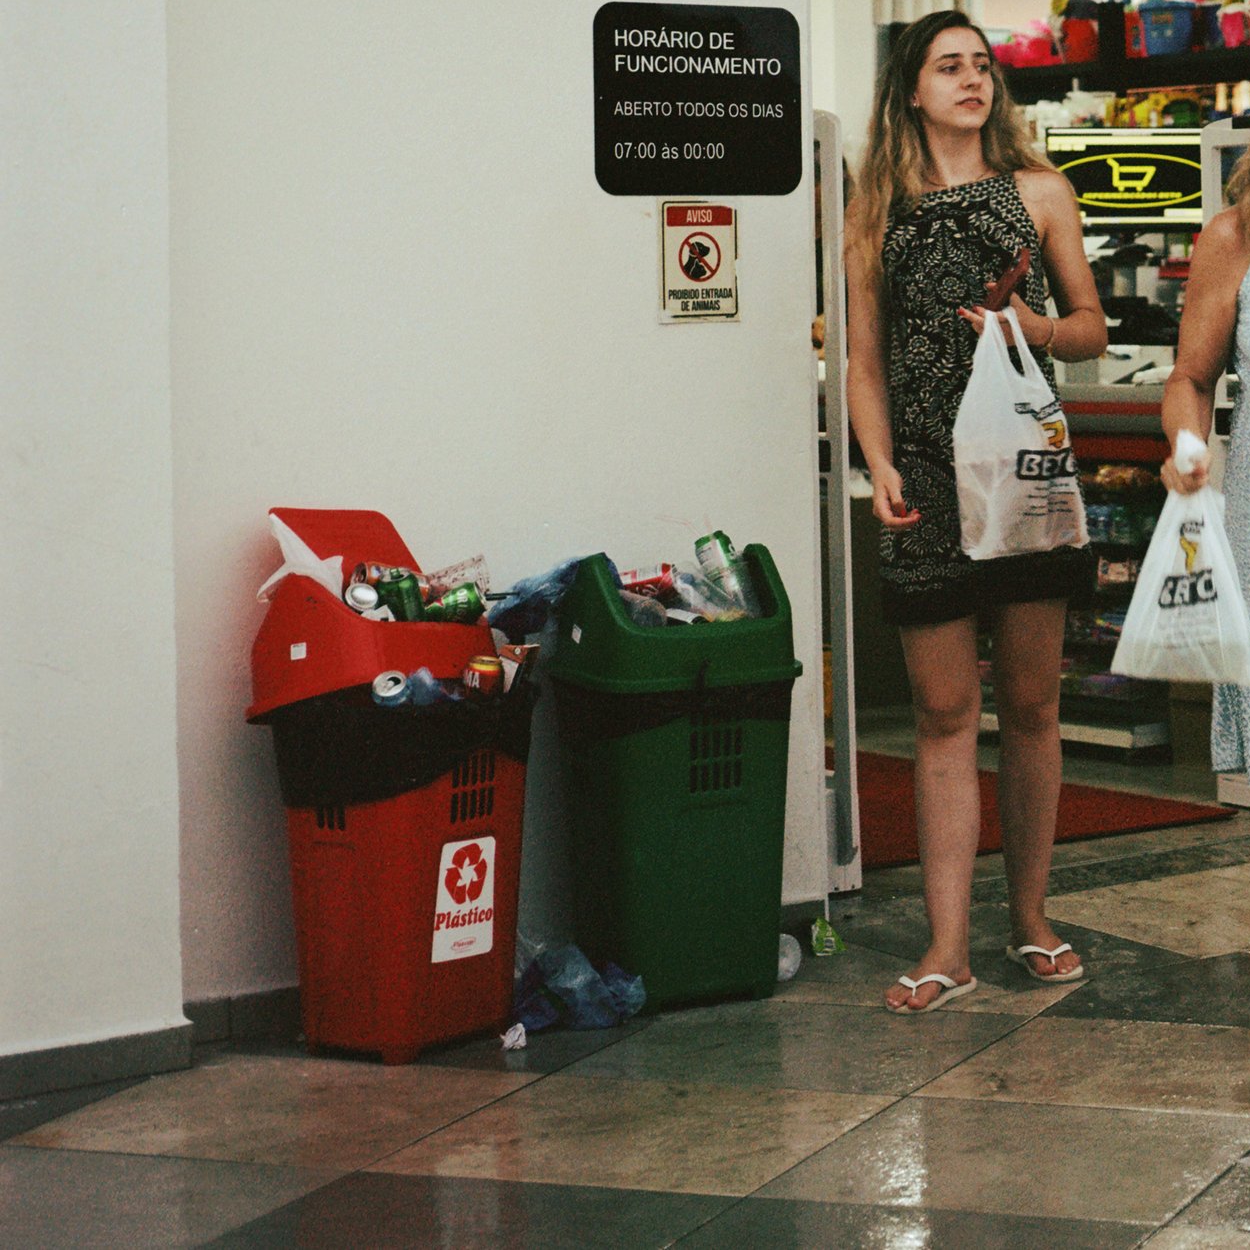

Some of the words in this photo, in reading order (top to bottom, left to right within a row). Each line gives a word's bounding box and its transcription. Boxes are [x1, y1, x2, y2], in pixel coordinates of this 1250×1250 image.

[614, 27, 704, 50] HORÁRIO
[709, 32, 735, 50] DE
[614, 54, 782, 76] FUNCIONAMENTO
[613, 101, 673, 117] ABERTO
[675, 102, 725, 118] TODOS
[728, 103, 749, 118] OS
[752, 104, 784, 118] DIAS
[614, 142, 657, 160] 07:00
[661, 143, 680, 160] às
[683, 142, 725, 160] 00:00
[686, 209, 713, 223] AVISO
[668, 289, 700, 301] PROIBIDO
[701, 288, 733, 300] ENTRADA
[681, 301, 690, 312] DE
[692, 300, 721, 312] ANIMAIS
[434, 907, 493, 931] Plástico
